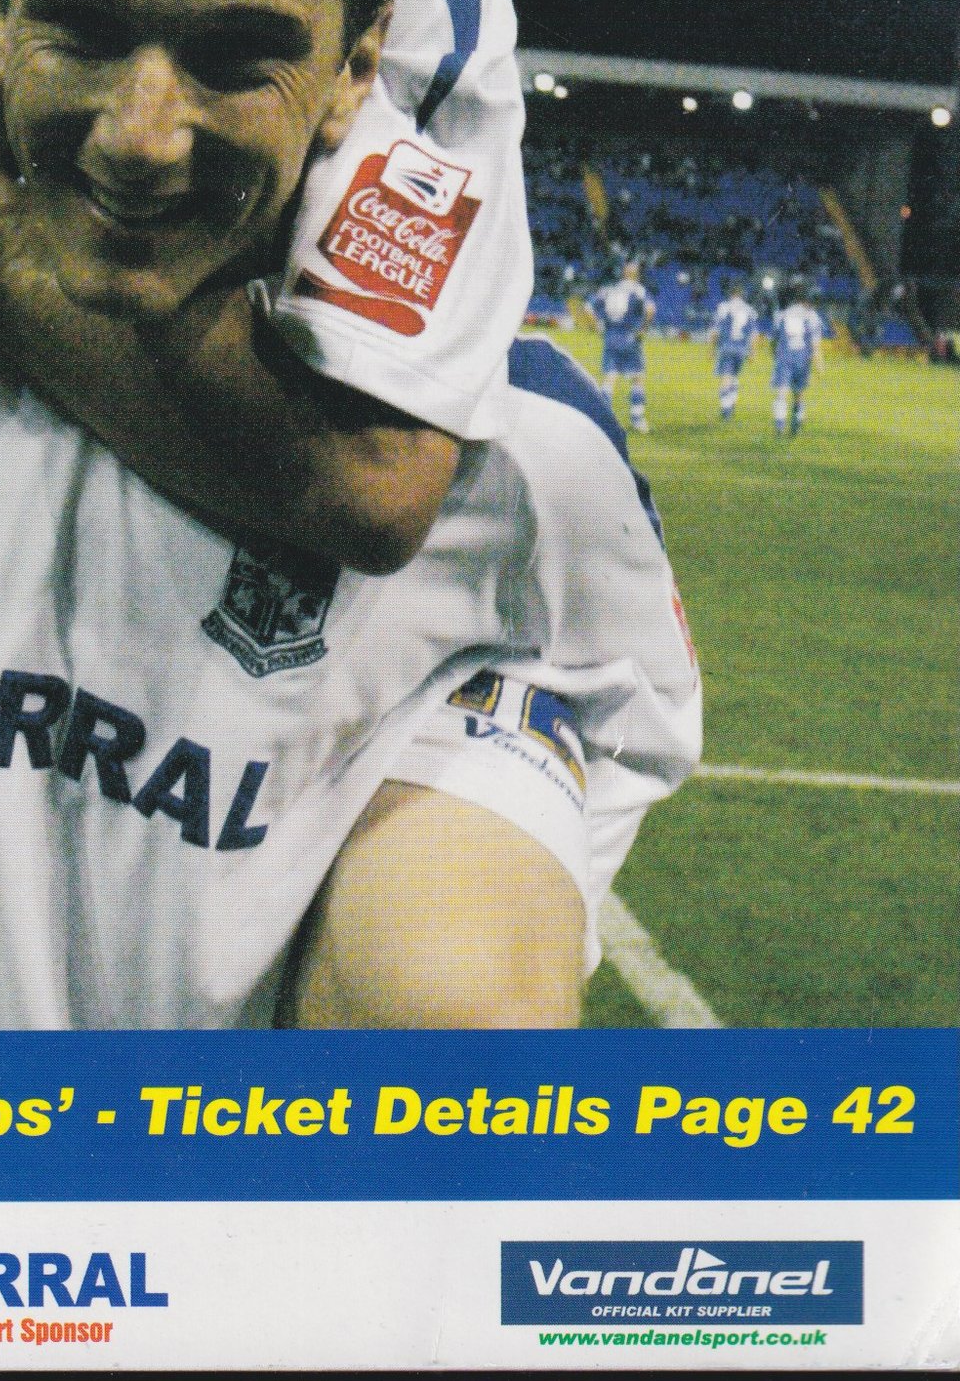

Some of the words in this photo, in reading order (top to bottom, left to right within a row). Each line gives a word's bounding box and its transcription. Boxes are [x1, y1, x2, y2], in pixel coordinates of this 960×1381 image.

[327, 233, 435, 301] LEAGUE
[338, 218, 437, 281] FOOTBALL
[141, 1086, 351, 1136] Ticket
[374, 1086, 609, 1135] Details
[636, 1086, 807, 1147] Page
[833, 1086, 915, 1133] 42
[528, 1248, 834, 1296] Vandanel
[20, 1317, 112, 1345] Sponsor
[592, 1306, 661, 1316] OFFICIAL
[666, 1307, 693, 1316] KIT
[697, 1307, 771, 1316] SUPPLIER
[539, 1329, 825, 1349] www.vandanelsport.co.uk
